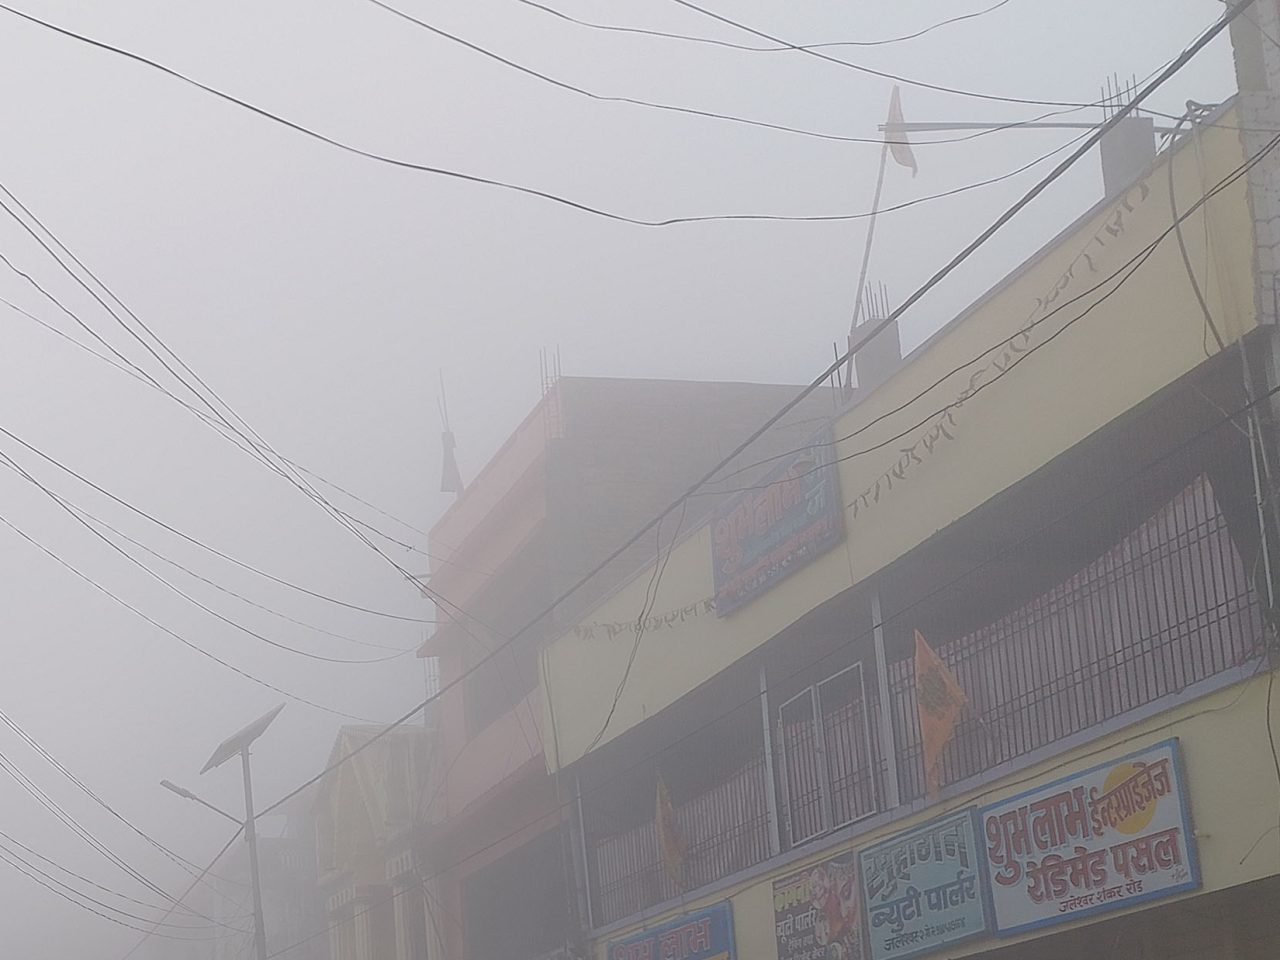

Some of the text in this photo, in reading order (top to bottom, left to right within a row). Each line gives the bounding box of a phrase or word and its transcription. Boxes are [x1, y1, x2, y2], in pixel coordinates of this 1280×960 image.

[986, 806, 1032, 885] शुभ
[1030, 786, 1090, 851] लाभ
[1026, 826, 1182, 903] रेडिमेड पसल
[869, 884, 923, 934] ब्युटी
[923, 869, 976, 912] पार्लर
[1058, 879, 1143, 913] जलेश्वर शंकर रोड
